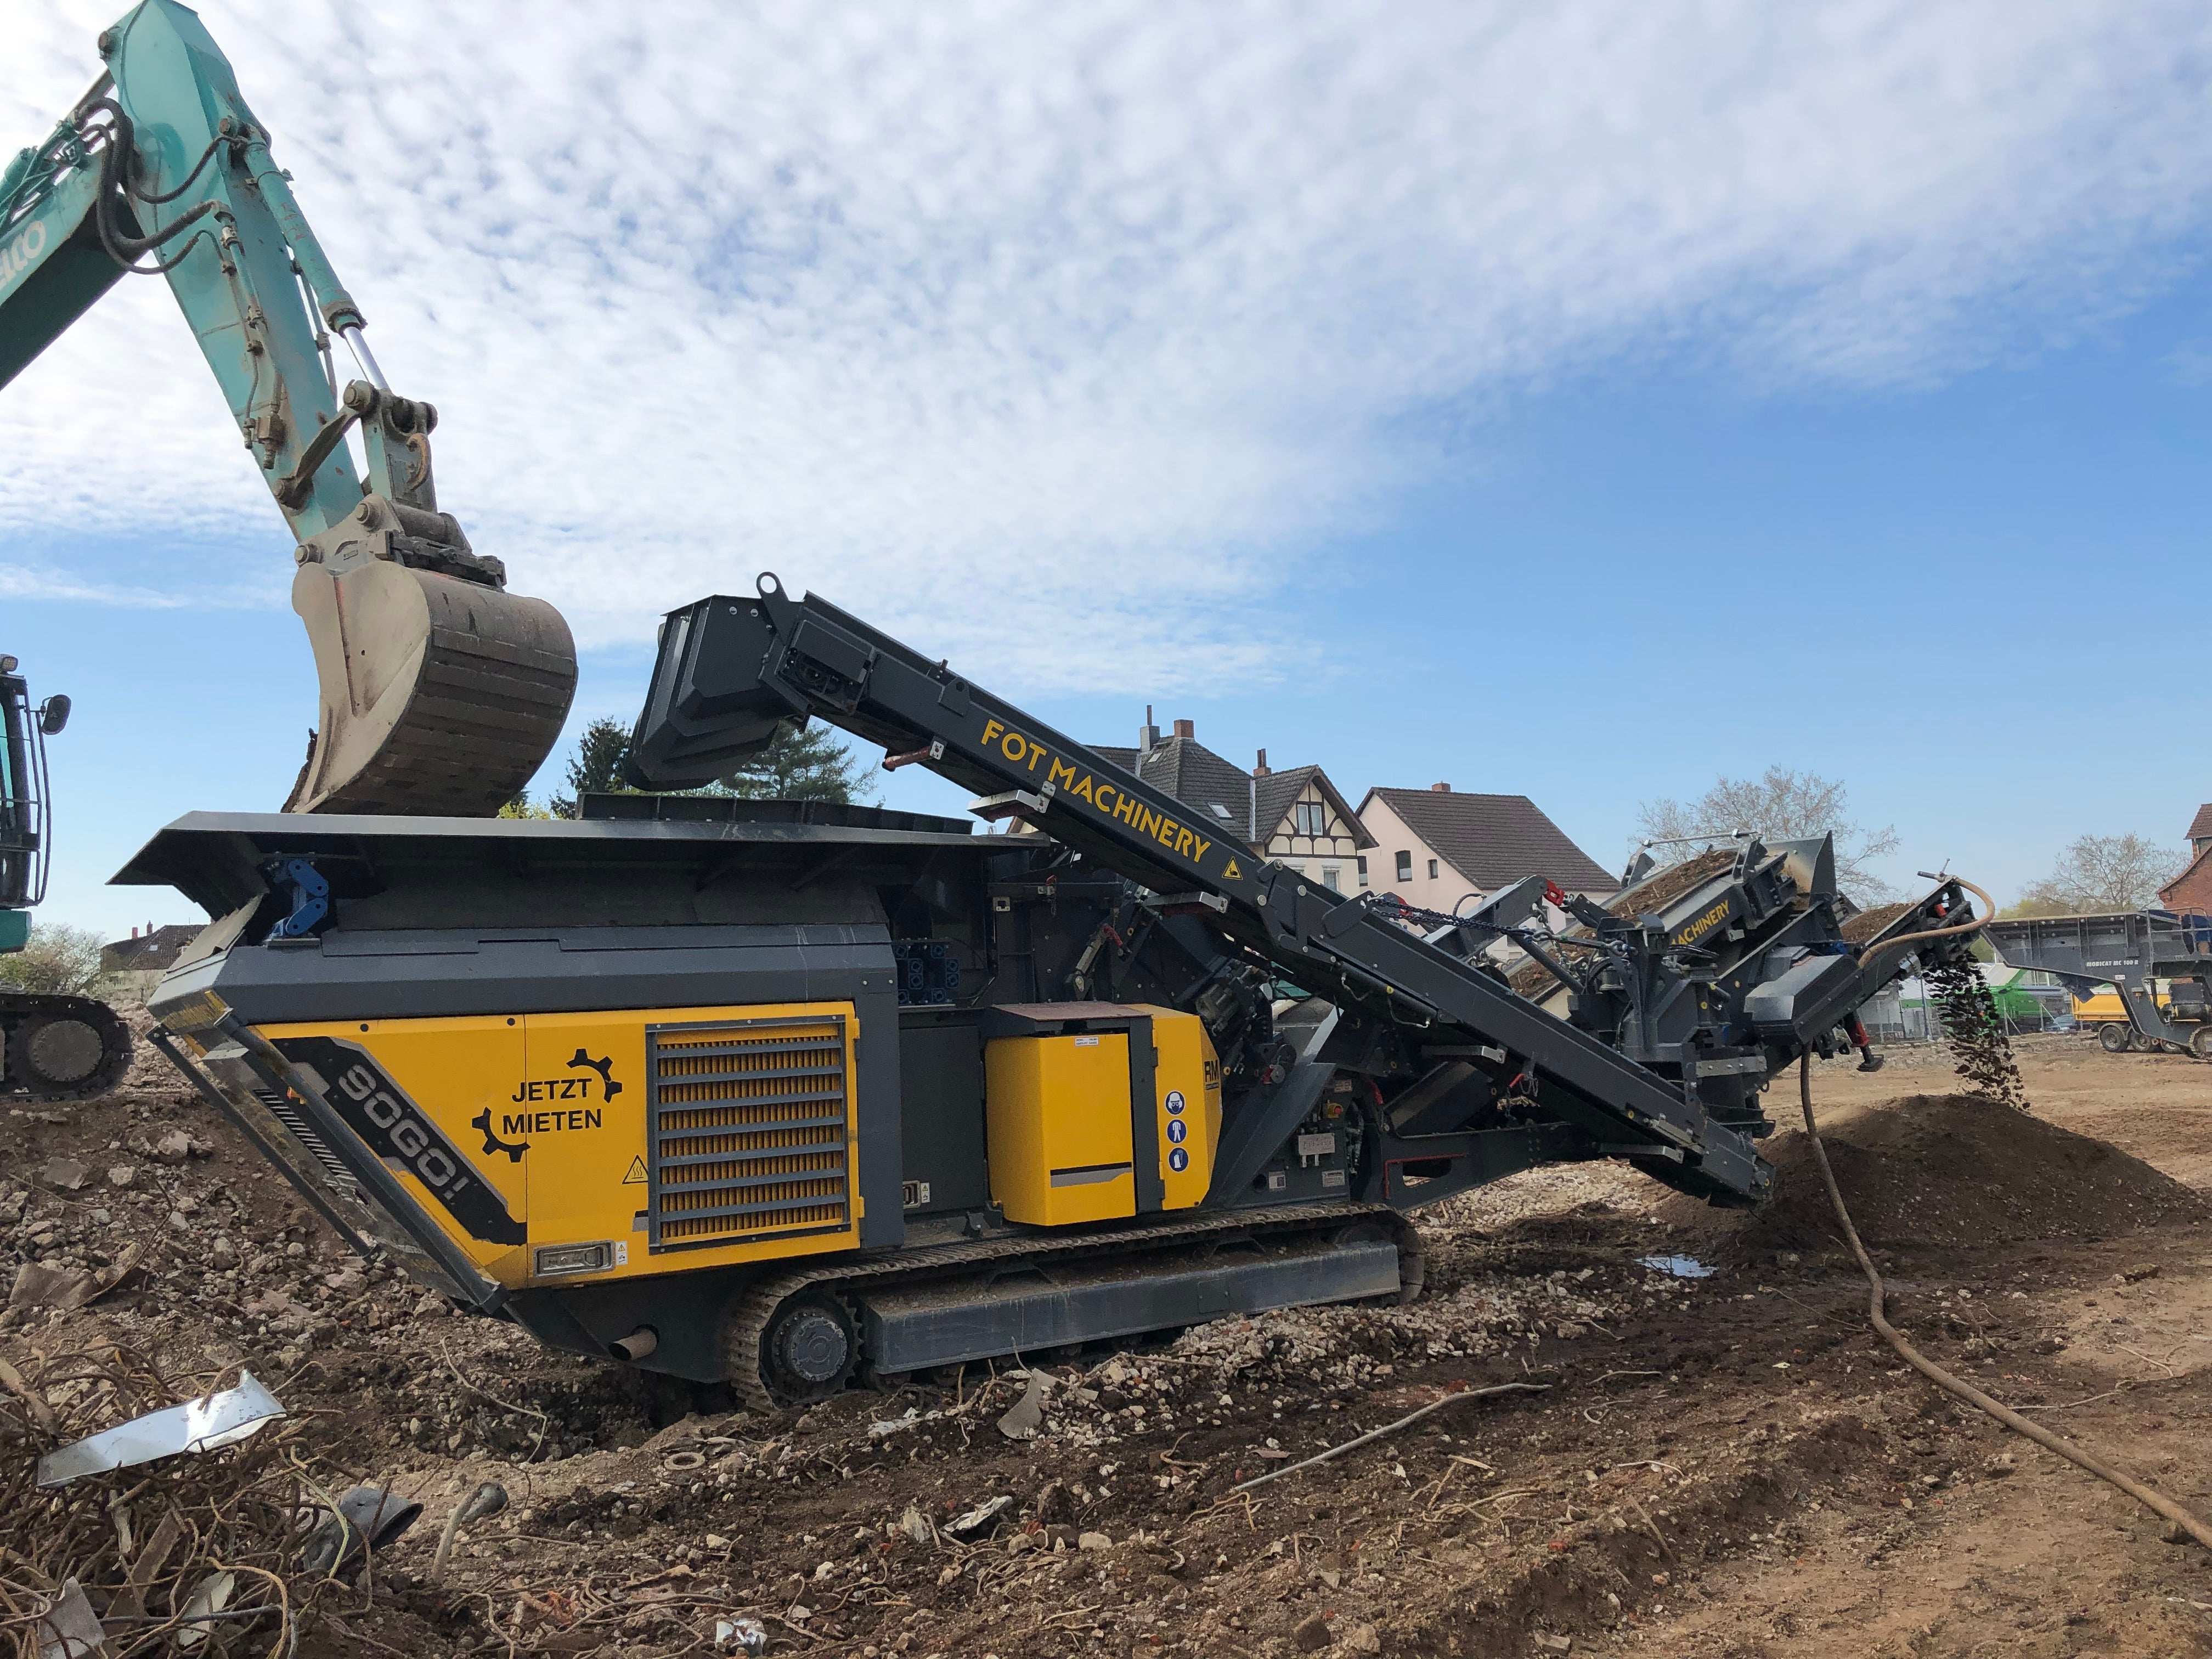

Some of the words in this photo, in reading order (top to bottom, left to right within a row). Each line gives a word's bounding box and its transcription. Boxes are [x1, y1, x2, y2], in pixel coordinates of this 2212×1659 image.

[0, 221, 46, 290] LCO
[981, 719, 1047, 771] FOT
[1048, 757, 1211, 863] MACHINERY
[1204, 1059, 1219, 1082] RM
[512, 1078, 592, 1103] JETZT
[503, 1108, 601, 1135] MIETEN
